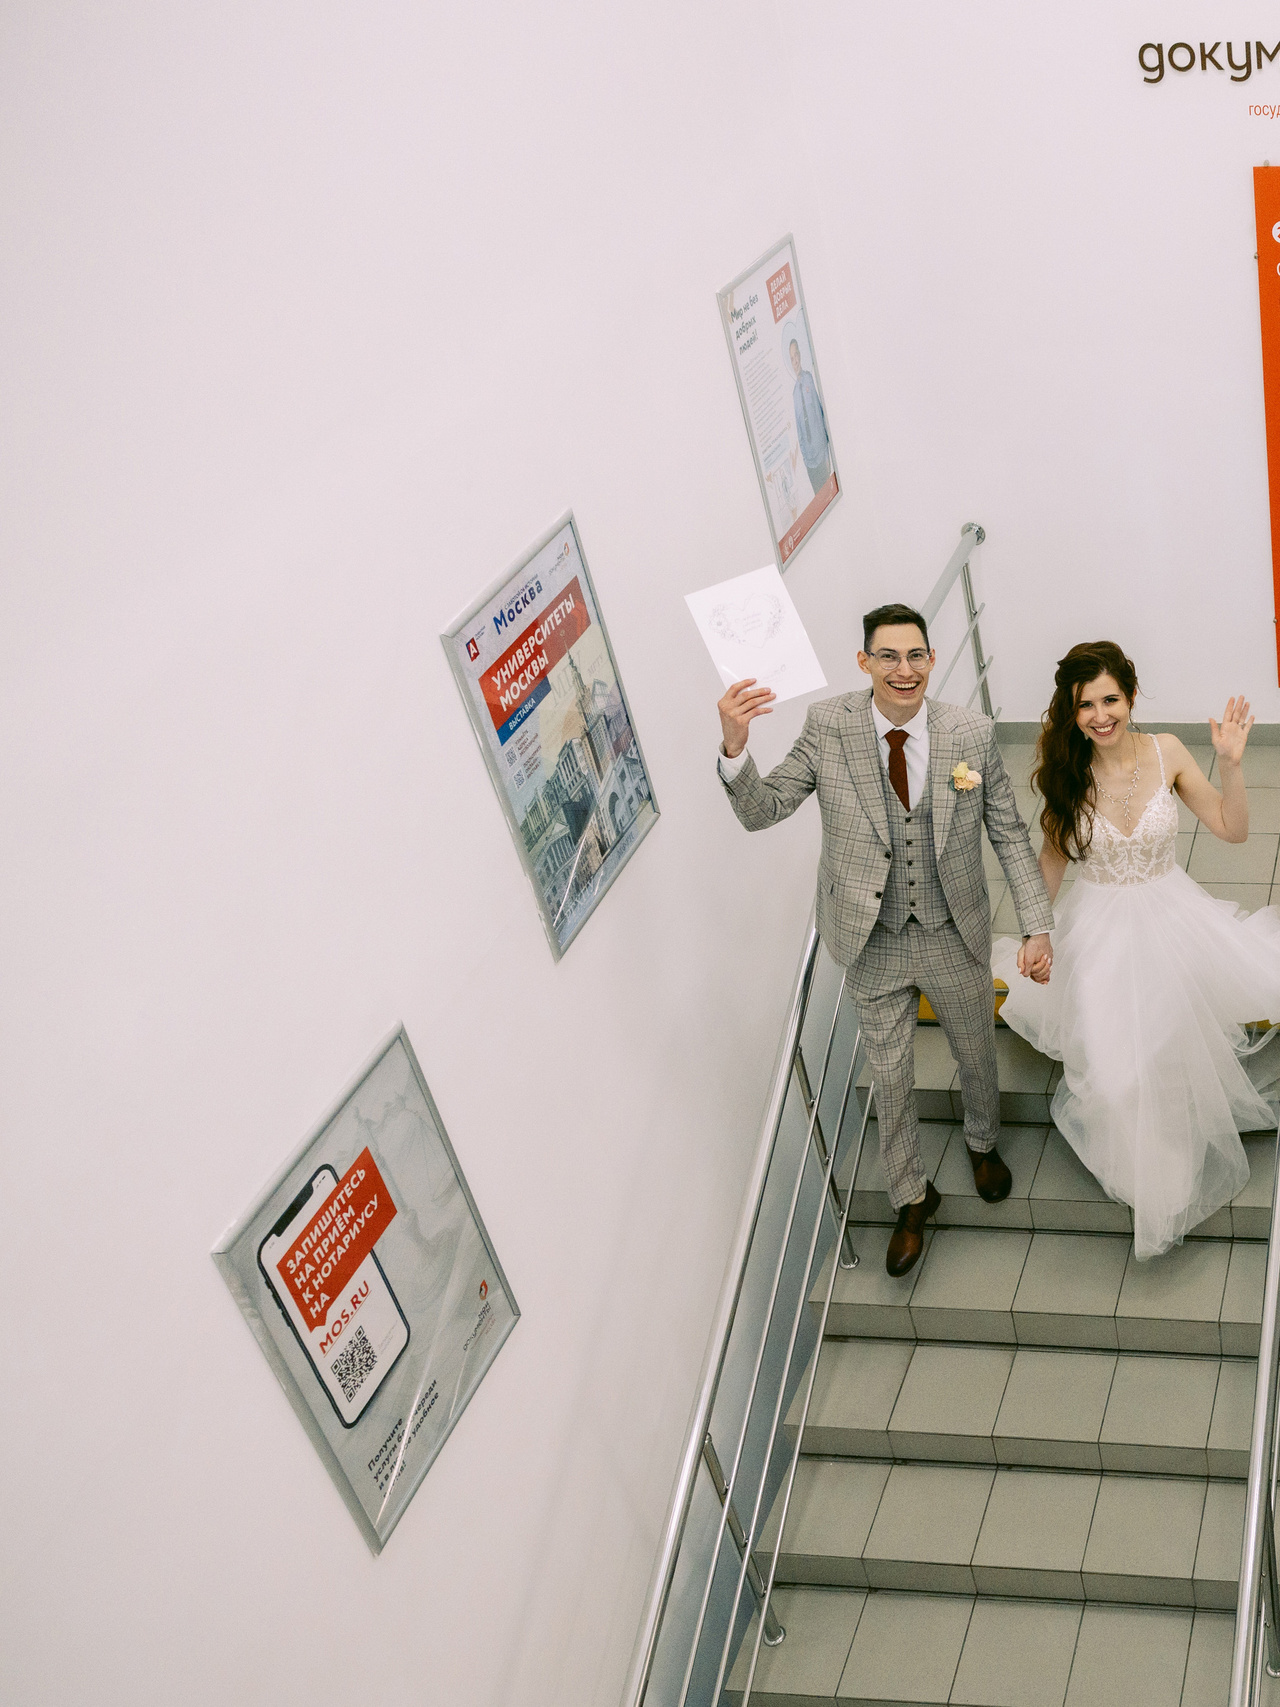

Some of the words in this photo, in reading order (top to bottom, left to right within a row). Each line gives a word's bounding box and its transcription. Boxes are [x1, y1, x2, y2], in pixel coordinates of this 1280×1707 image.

[770, 270, 787, 294] ДЕЛАЙ
[492, 579, 543, 635] Москва
[491, 593, 576, 690] УНИВЕРСИТЕТЫ
[499, 649, 550, 712] МОСКВЫ
[508, 697, 536, 731] ВЫСТАВКА
[286, 1168, 366, 1275] ЗАПИШИТЕСЬ
[294, 1266, 316, 1290] НА
[314, 1205, 356, 1266] ПРИЁМ
[301, 1291, 315, 1304] К
[311, 1194, 379, 1291] НОТАРИУСУ
[308, 1292, 331, 1319] НА
[318, 1280, 370, 1354] MOS.RU
[368, 1418, 403, 1471] Получите
[373, 1444, 398, 1483] услуги
[411, 1379, 437, 1421] череди
[411, 1392, 439, 1437] удобное
